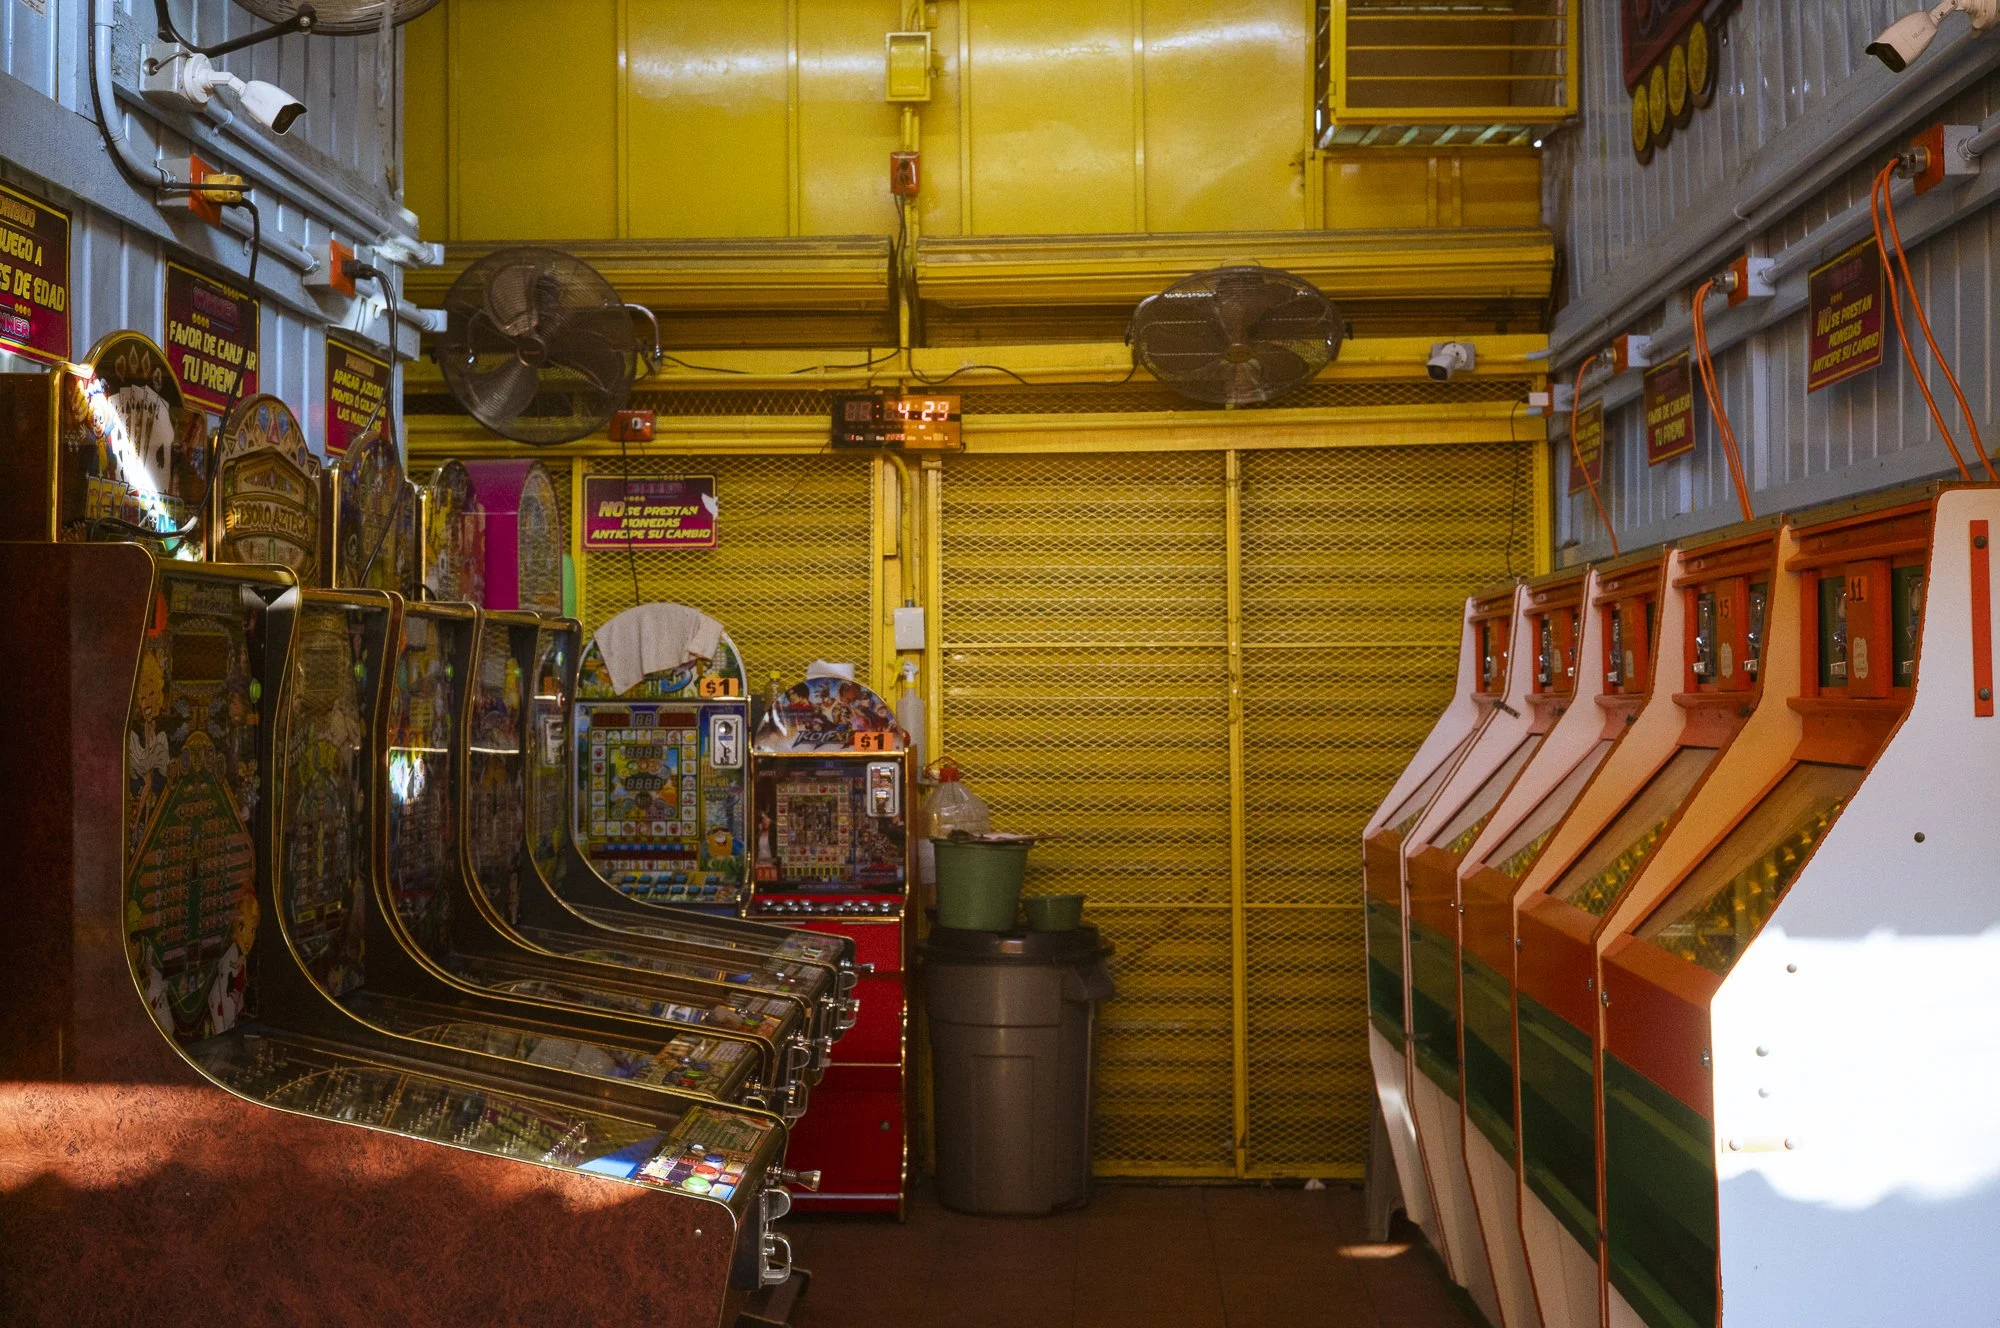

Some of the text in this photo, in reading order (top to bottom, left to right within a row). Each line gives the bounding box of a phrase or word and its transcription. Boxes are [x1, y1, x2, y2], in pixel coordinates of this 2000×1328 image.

[35, 246, 42, 267] A
[13, 268, 32, 300] DE
[33, 277, 65, 312] EDAD
[1817, 294, 1873, 336] NO SE PRESTAN
[169, 320, 202, 351] FAVOR
[203, 333, 217, 356] DE
[1828, 320, 1862, 349] MONEDAS
[1812, 332, 1879, 374] ANTICIPE SU CAMBIO
[182, 354, 200, 383] TU
[337, 406, 350, 422] LAS
[232, 500, 311, 541] TESORO AZTECA
[599, 501, 625, 517] NO
[643, 506, 699, 516] PRESTAN
[621, 518, 681, 528] MONEDAS
[648, 529, 664, 539] SU
[665, 529, 711, 539] CAMBIO
[705, 679, 730, 695] $1
[860, 733, 885, 750] $1
